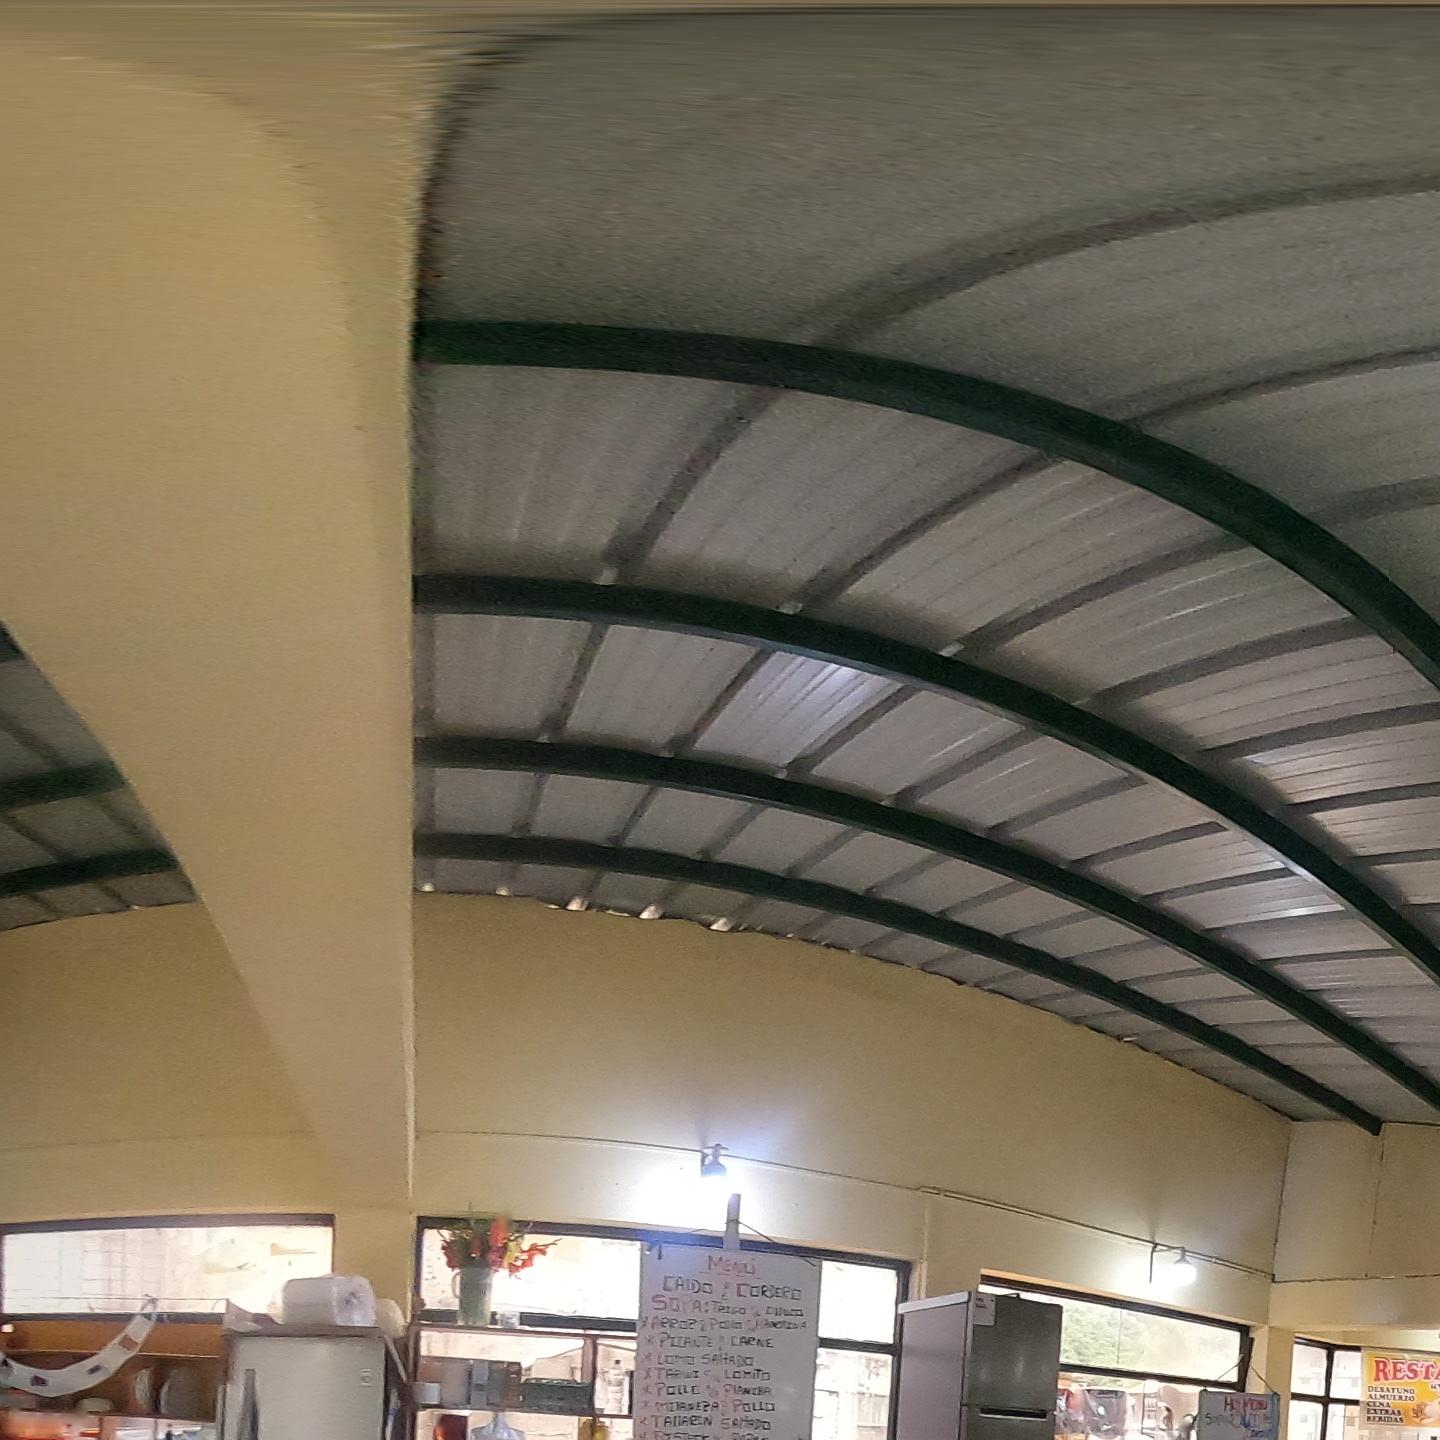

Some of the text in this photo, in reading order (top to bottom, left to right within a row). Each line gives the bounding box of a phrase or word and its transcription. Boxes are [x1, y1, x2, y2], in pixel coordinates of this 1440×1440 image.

[735, 1282, 803, 1301] CORDERO
[731, 1335, 775, 1349] CARNE
[657, 1353, 695, 1366] LOMO
[724, 1367, 772, 1381] LOMITO
[655, 1382, 701, 1396] POLLO
[1367, 1394, 1415, 1402] ALMUERZO
[732, 1399, 777, 1413] POLLO
[1366, 1401, 1391, 1409] CENA
[1366, 1408, 1402, 1417] EXTRAS
[1366, 1415, 1404, 1424] BEBIDAS
